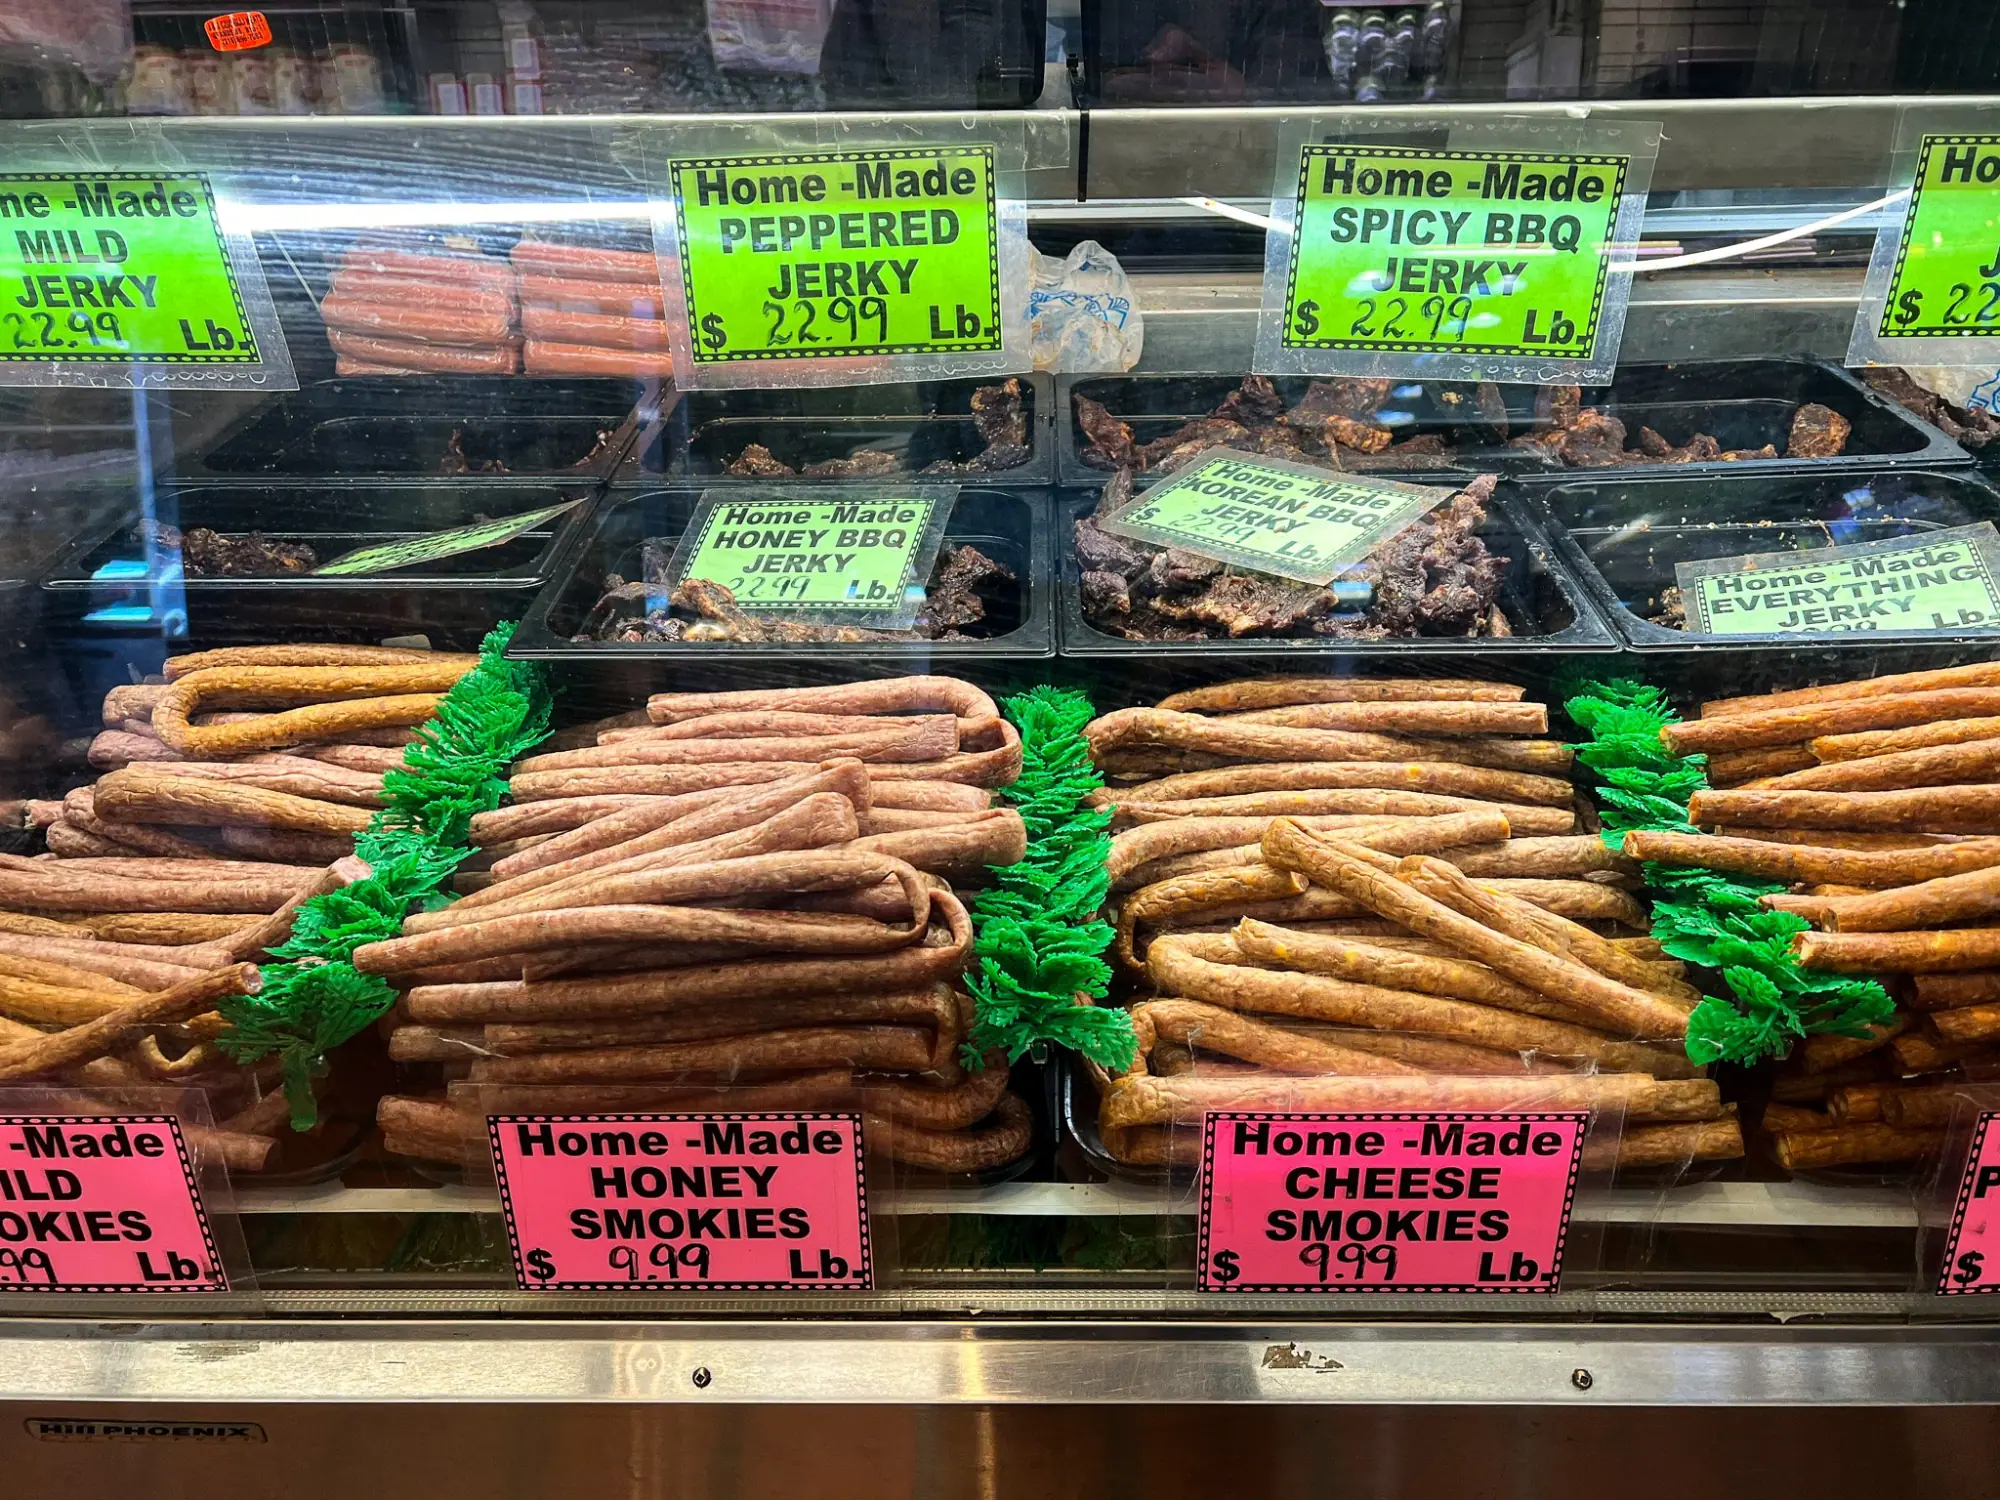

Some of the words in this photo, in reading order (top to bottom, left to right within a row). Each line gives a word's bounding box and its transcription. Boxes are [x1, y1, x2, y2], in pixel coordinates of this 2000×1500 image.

[696, 169, 826, 206] Home
[840, 159, 977, 200] -Made
[1322, 157, 1453, 197] Home
[1466, 163, 1605, 203] -Made
[1940, 146, 2000, 183] Ho
[64, 182, 198, 218] -Made
[14, 229, 128, 264] MILD
[719, 208, 960, 254] PEPPERED
[1330, 207, 1472, 247] SPICY
[1484, 212, 1582, 254] BBQ
[16, 275, 157, 308] JERKY
[768, 258, 919, 300] JERKY
[1371, 257, 1528, 296] JERKY
[1293, 300, 1320, 339] $
[1350, 295, 1473, 342] 22.99
[1522, 308, 1591, 345] Lb.
[1894, 288, 1923, 328] $
[1943, 282, 2000, 324] 22
[3, 312, 125, 349] 22.99
[179, 319, 252, 351] Lb.
[701, 312, 727, 352] $
[762, 297, 888, 347] 22.99
[929, 304, 995, 340] Lb.
[1182, 477, 1307, 513] KOREAN
[1306, 501, 1382, 529] BBQ
[1211, 464, 1295, 491] Home
[1299, 484, 1391, 510] -Made
[723, 508, 812, 526] Home
[820, 505, 916, 523] -Made
[1200, 502, 1311, 534] JERKY
[712, 530, 830, 549] HONEY
[835, 528, 907, 549] BBQ
[1274, 540, 1321, 562] Lb.
[742, 554, 856, 573] JERKY
[1716, 571, 1827, 594] Home
[1840, 548, 1962, 578] -Made
[846, 579, 898, 600] Lb.
[1710, 564, 1983, 615] EVERYTHING
[1778, 595, 1916, 628] JERKY
[10, 1126, 165, 1158] -Made
[517, 1124, 669, 1157] Home
[686, 1122, 843, 1155] -Made
[1233, 1122, 1385, 1156] Home
[1403, 1123, 1562, 1156] -Made
[591, 1165, 779, 1198] HONEY
[1285, 1167, 1502, 1200] CHEESE
[569, 1208, 810, 1240] SMOKIES
[1265, 1210, 1510, 1242] SMOKIES
[136, 1252, 217, 1281] Lb.
[527, 1248, 557, 1283] $
[609, 1243, 710, 1281] 9.99
[788, 1249, 863, 1279] Lb.
[1211, 1249, 1241, 1284] $
[1299, 1243, 1398, 1282] 9.99
[1477, 1252, 1554, 1282] Lb.
[1953, 1250, 1985, 1288] $
[103, 1425, 250, 1436] PHOENIX
